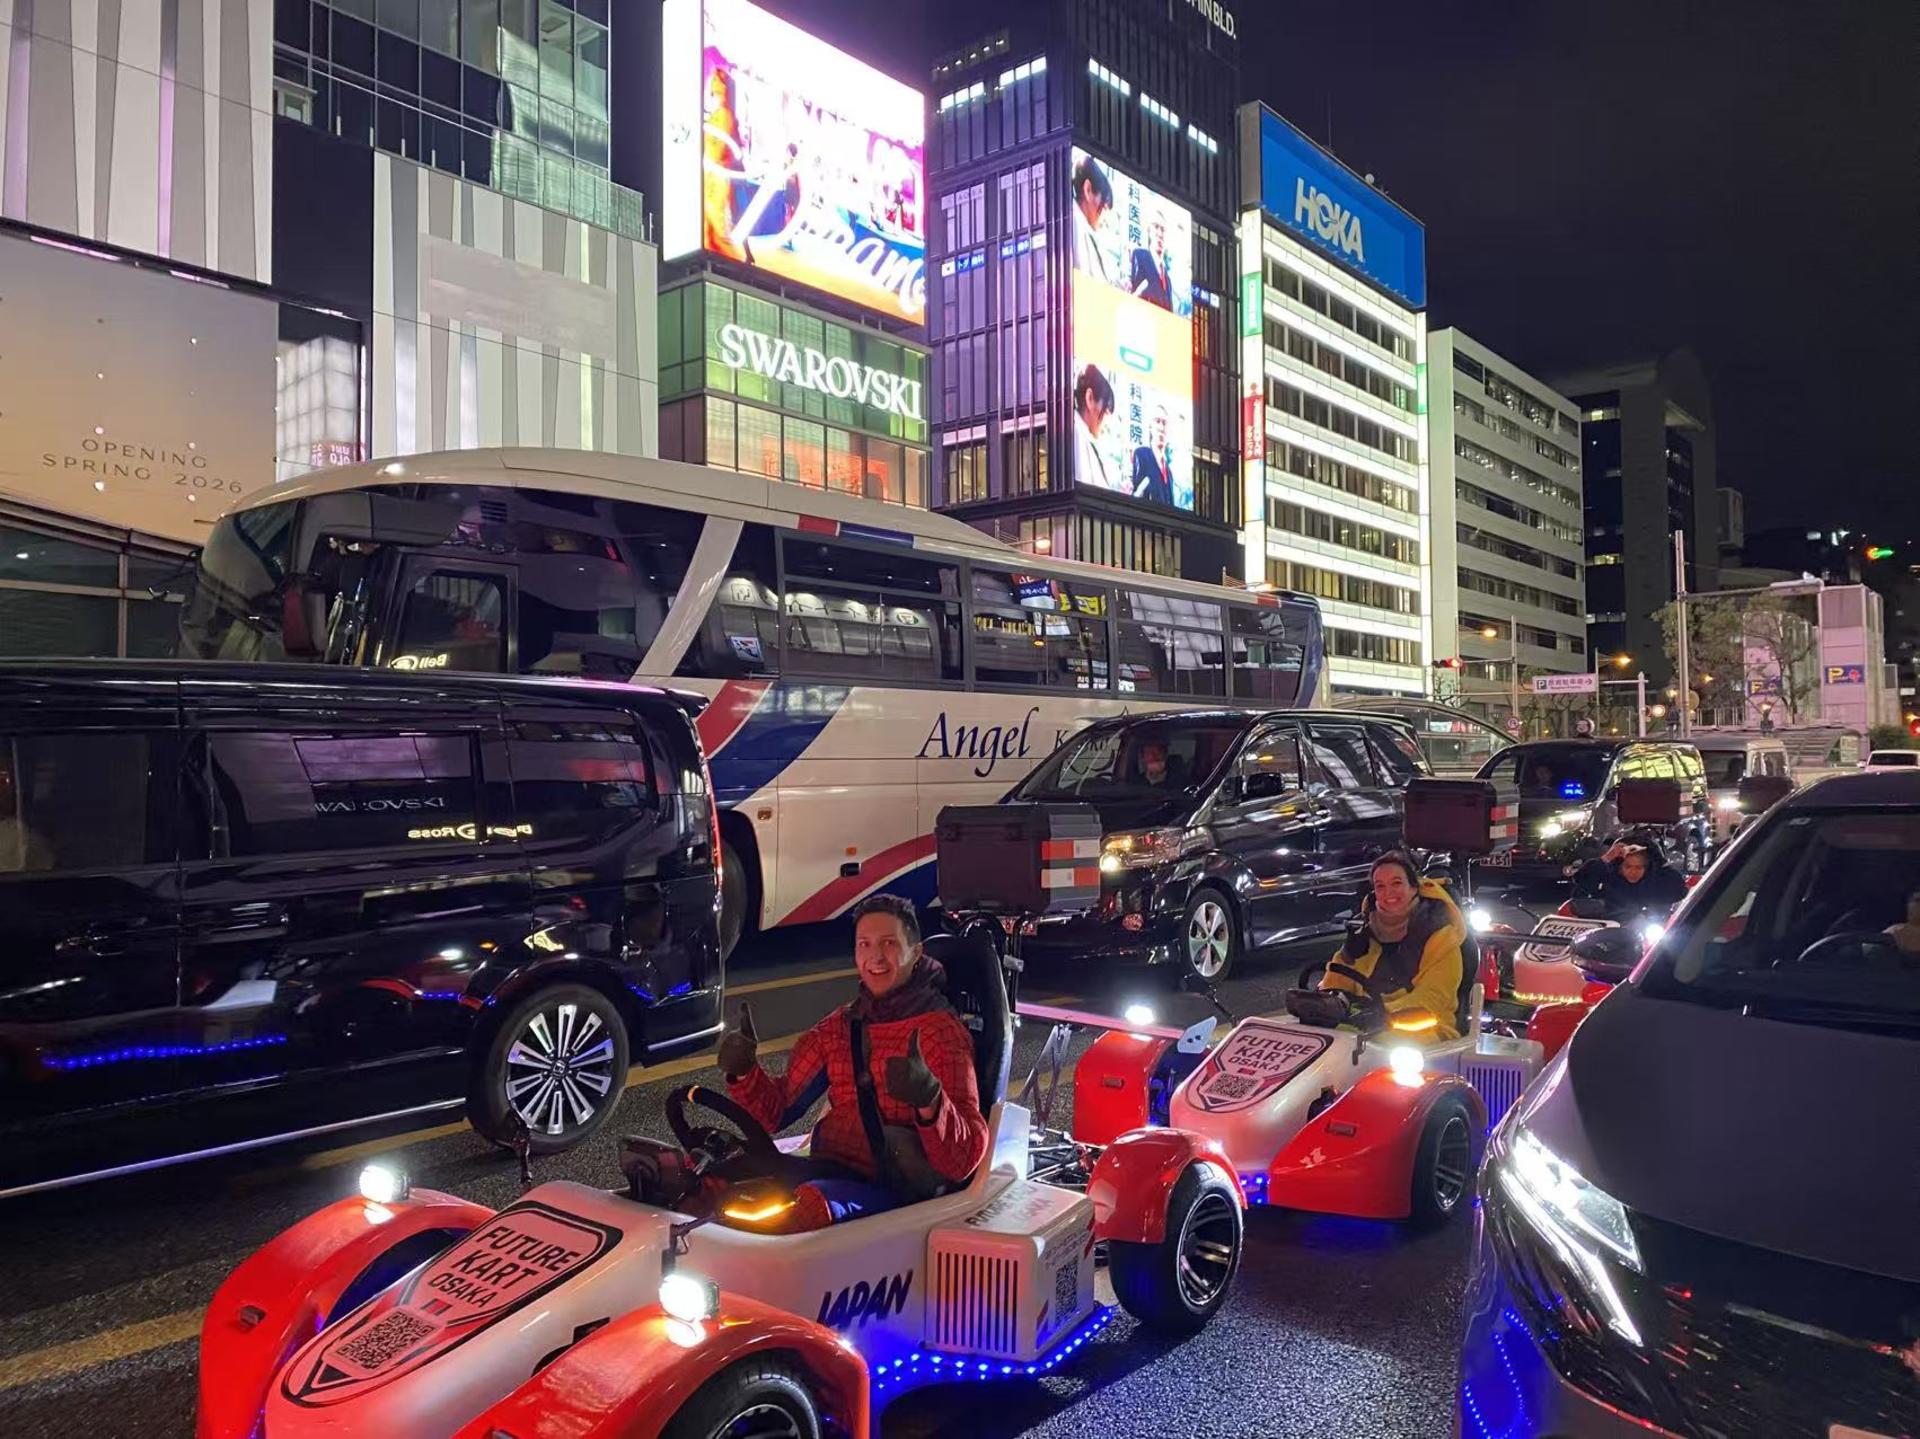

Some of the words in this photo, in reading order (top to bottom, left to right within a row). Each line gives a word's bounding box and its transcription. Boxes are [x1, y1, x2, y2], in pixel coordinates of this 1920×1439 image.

[1296, 177, 1365, 263] HOKA
[720, 323, 921, 420] SWAROVSKI
[42, 453, 151, 480] SPRING
[175, 473, 242, 494] 2026
[82, 438, 207, 469] OPENING
[915, 706, 1040, 777] Angel
[1228, 1056, 1281, 1071] OSAKA
[1234, 1046, 1297, 1063] KART
[1237, 1035, 1315, 1056] FUTURE
[451, 1249, 539, 1290] KART
[477, 1226, 582, 1272] FUTURE
[427, 1272, 500, 1309] OSAKA
[817, 1269, 913, 1328] JAPAN
